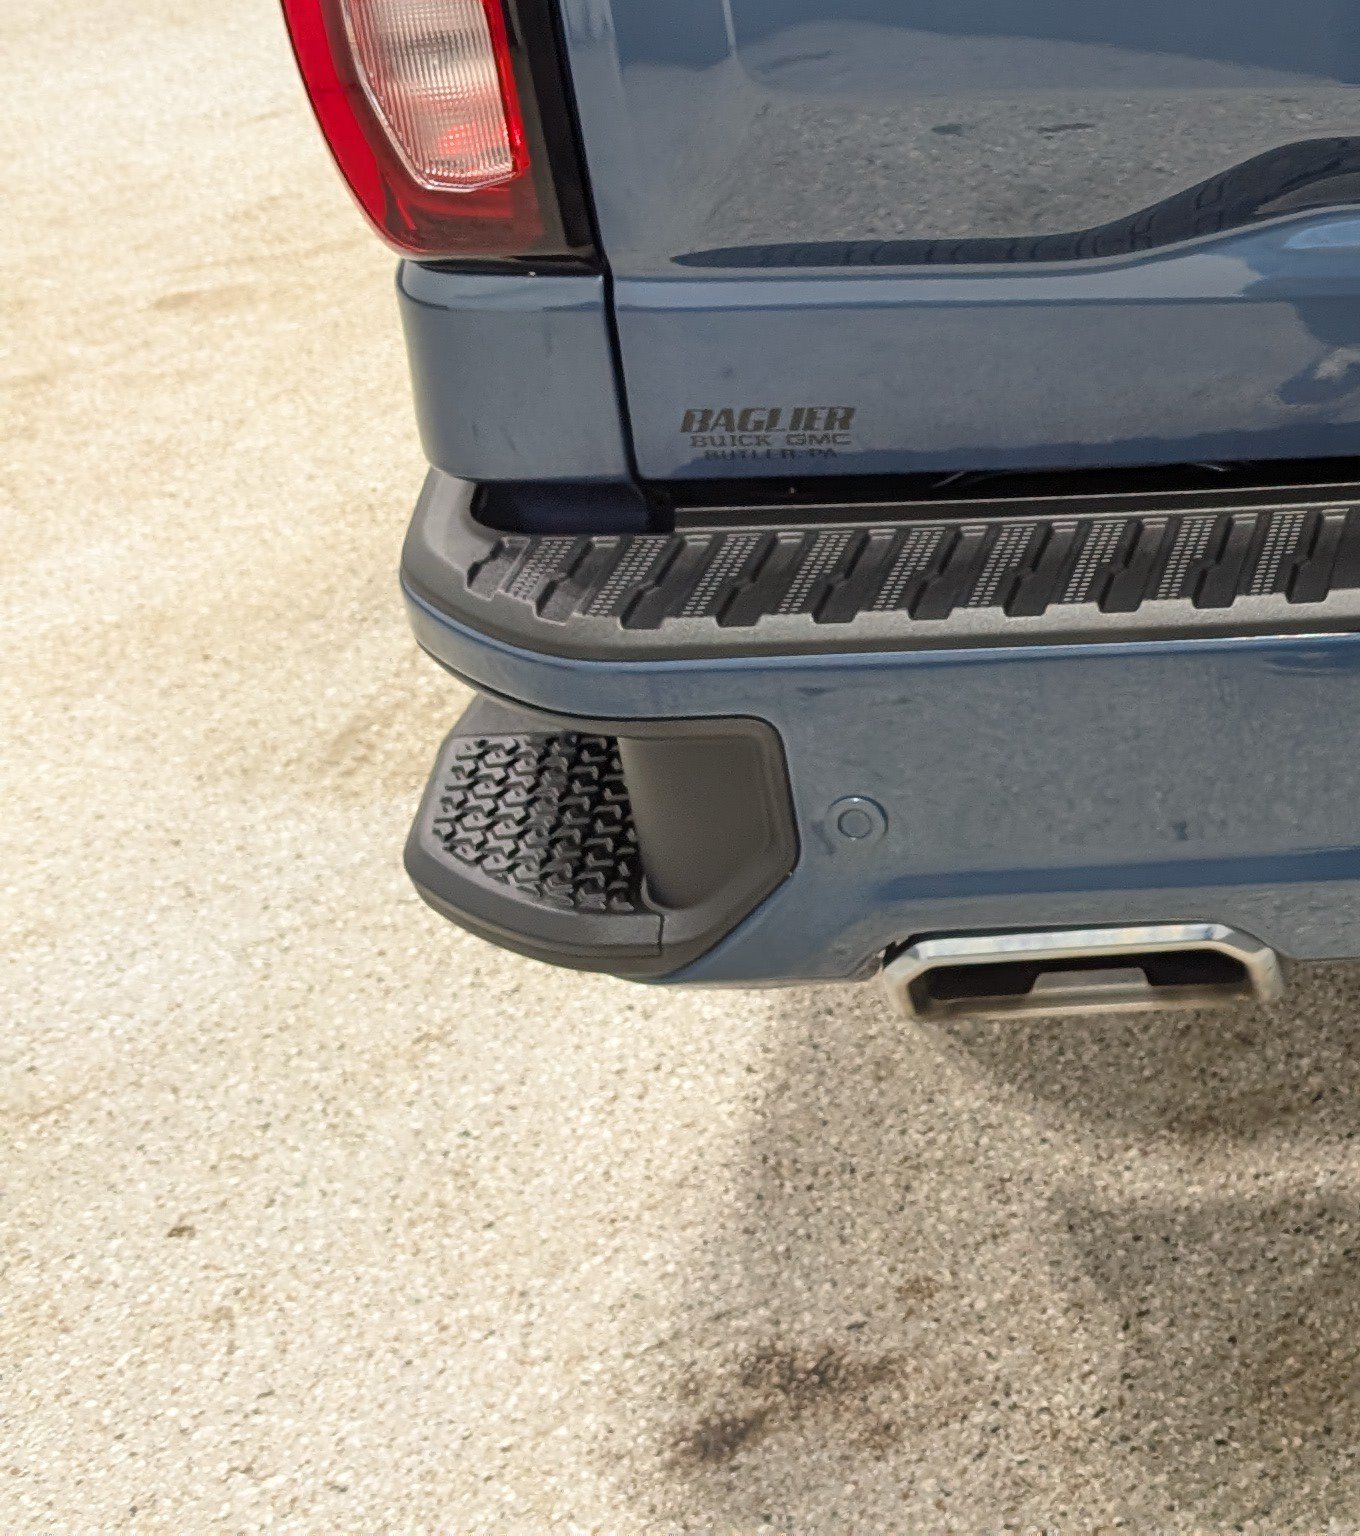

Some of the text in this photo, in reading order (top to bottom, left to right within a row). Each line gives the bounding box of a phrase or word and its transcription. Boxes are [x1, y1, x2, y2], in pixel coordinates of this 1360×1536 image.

[680, 406, 856, 433] BAGLIER
[690, 432, 853, 448] BUICK GMC
